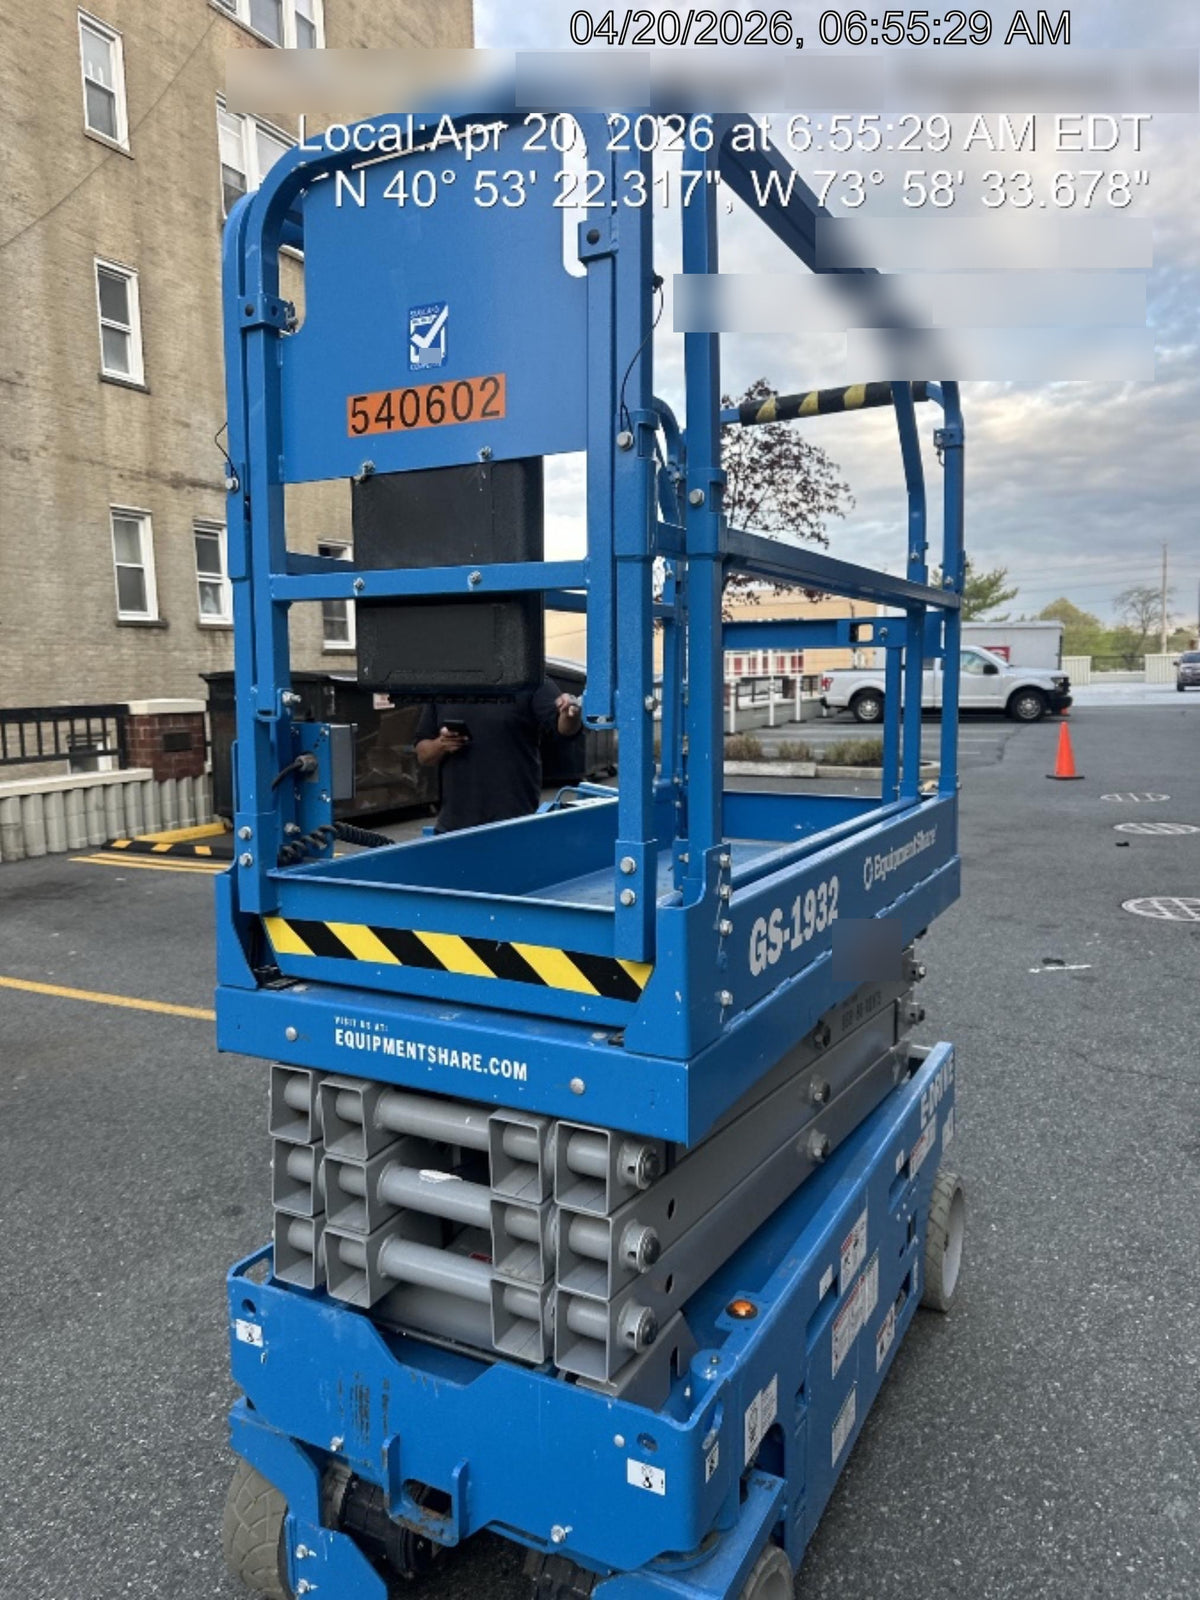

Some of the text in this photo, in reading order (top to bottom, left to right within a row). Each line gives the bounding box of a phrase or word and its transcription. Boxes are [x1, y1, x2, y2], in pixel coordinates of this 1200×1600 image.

[351, 376, 501, 435] 540602
[874, 828, 936, 881] EquipmentShare
[749, 875, 840, 976] GS-1932
[335, 1028, 528, 1082] EQUIPMENTSHARE.COM
